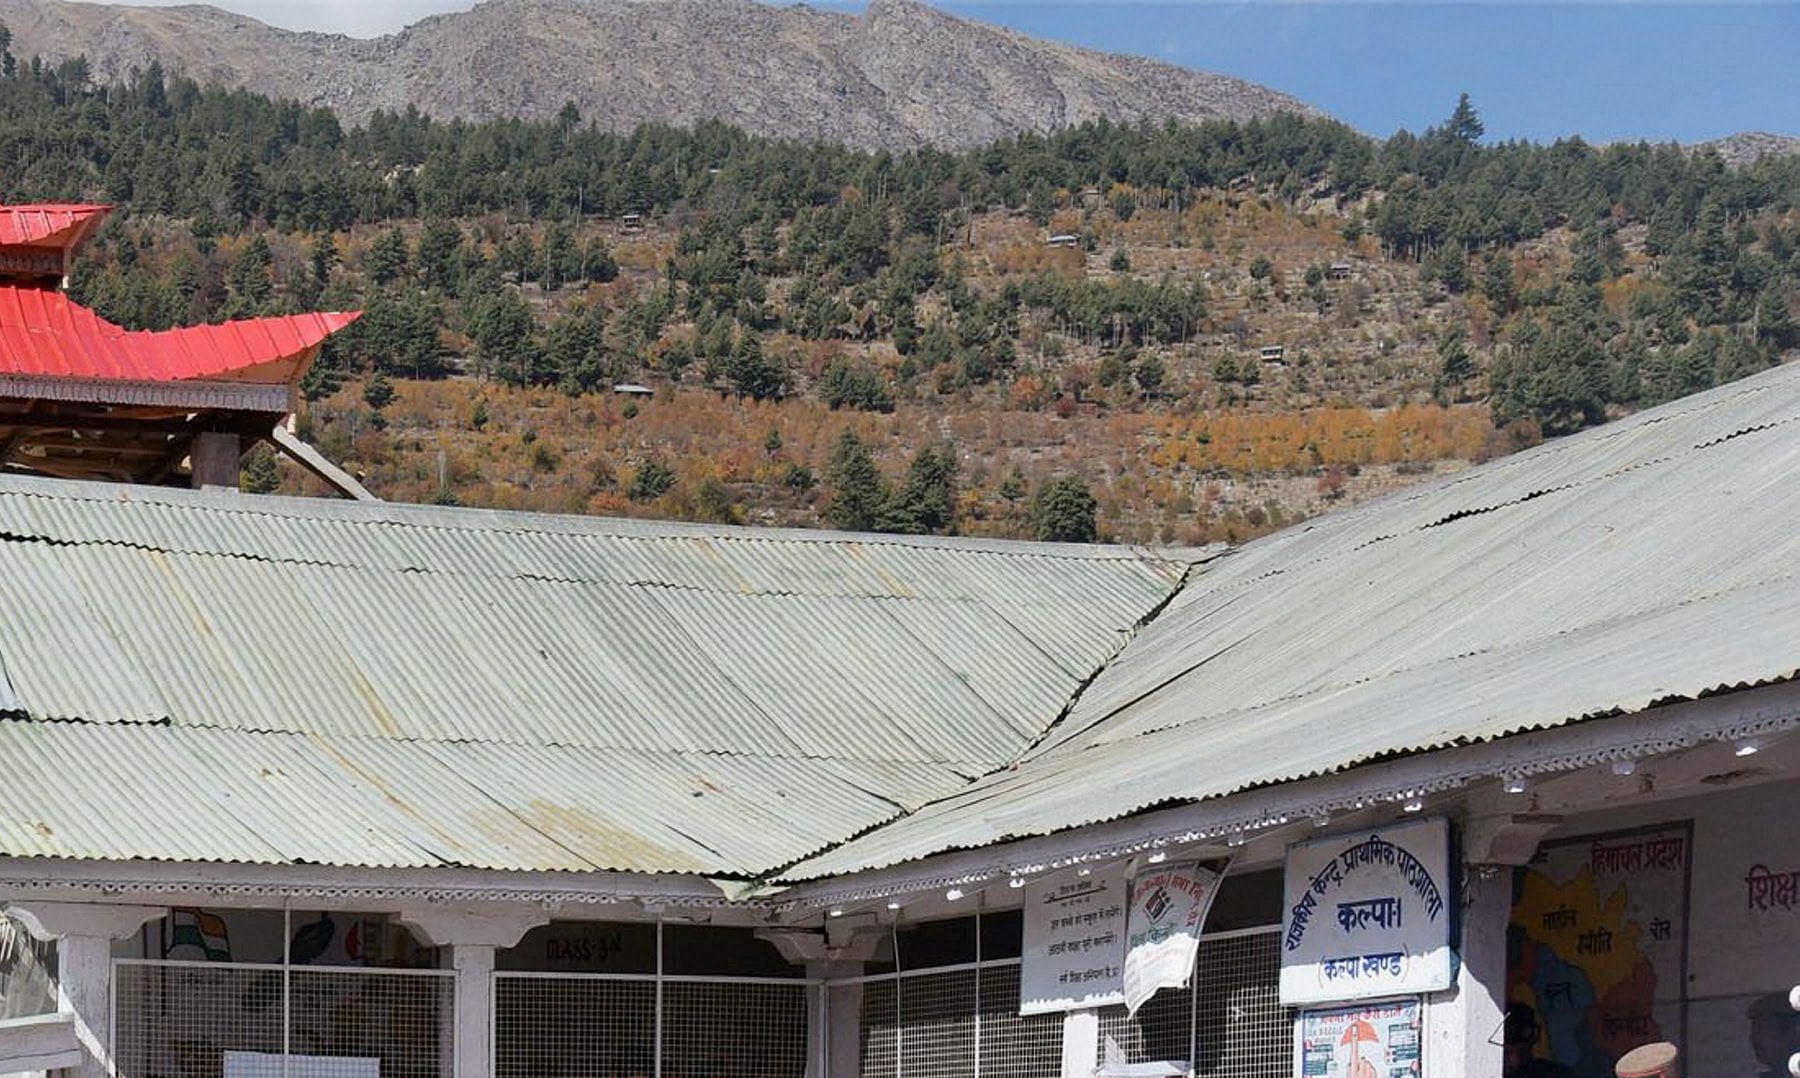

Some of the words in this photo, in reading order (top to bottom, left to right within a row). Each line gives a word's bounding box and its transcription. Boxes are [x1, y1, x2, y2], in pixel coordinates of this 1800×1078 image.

[1286, 890, 1318, 951] राजकीय
[1340, 835, 1395, 873] प्राथमिक
[1397, 847, 1443, 922] पाठशाला
